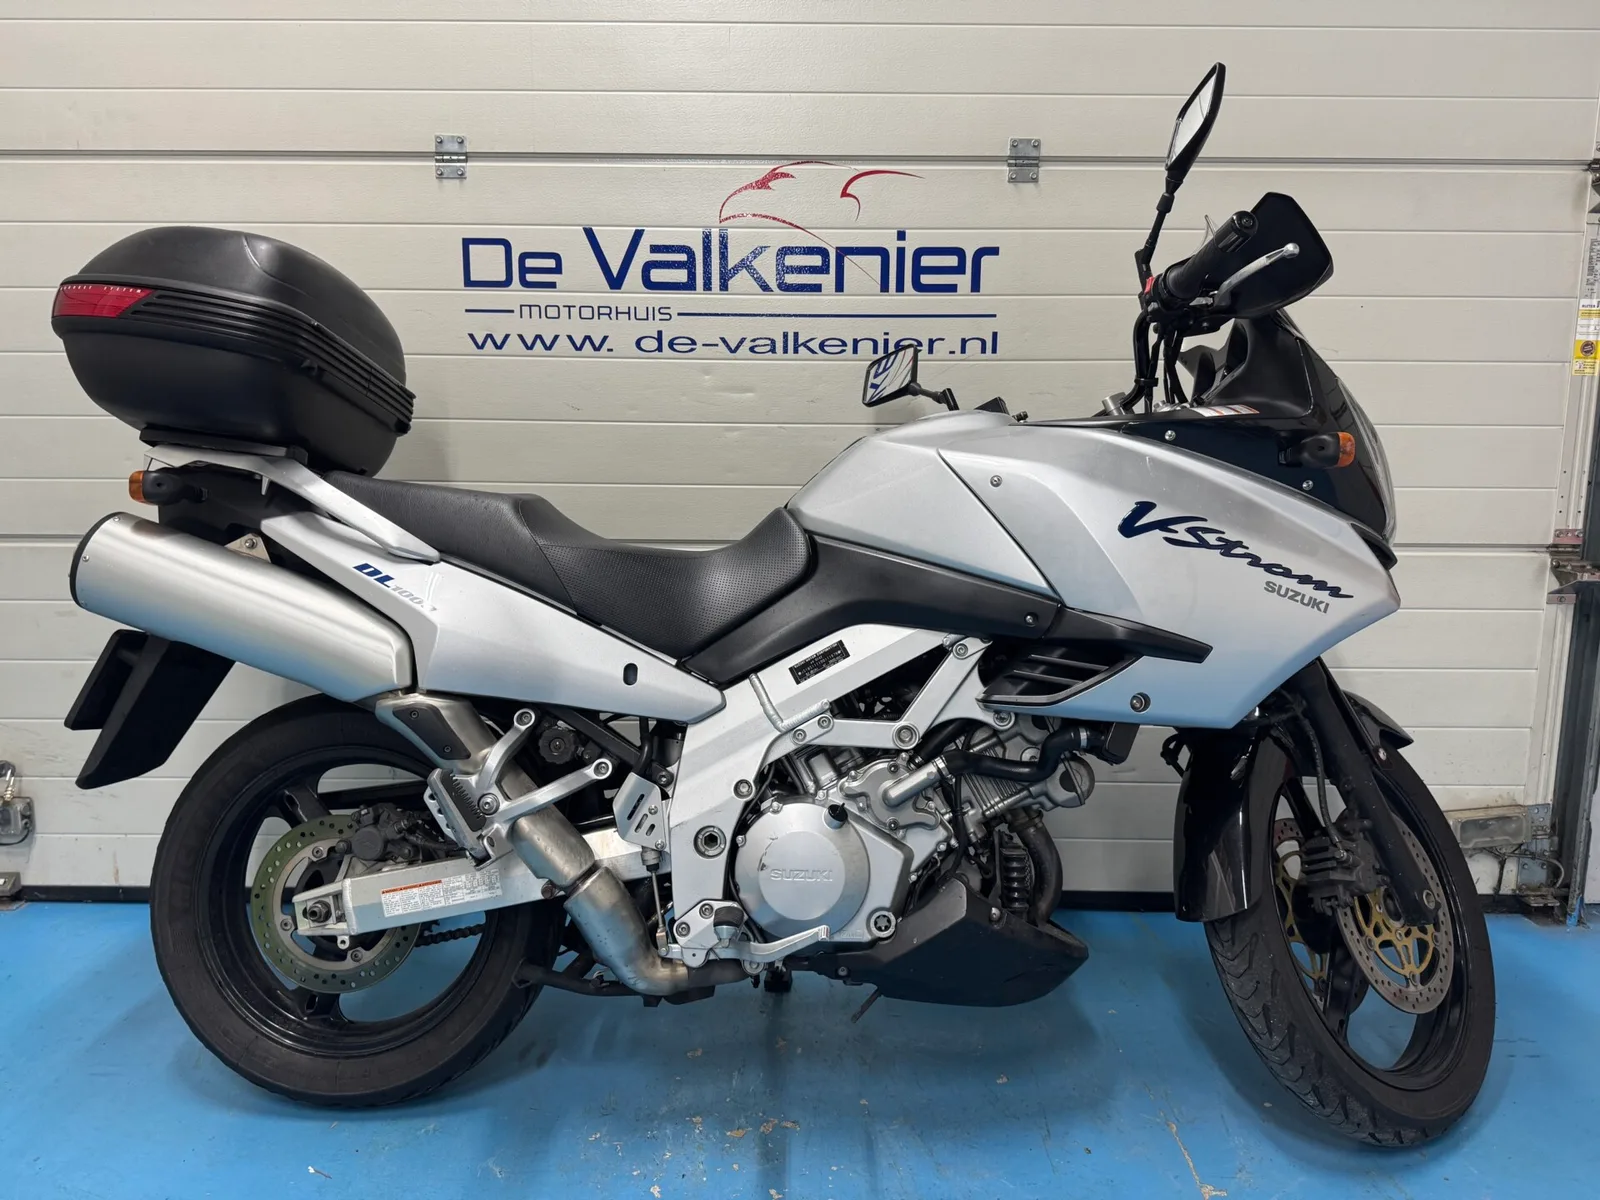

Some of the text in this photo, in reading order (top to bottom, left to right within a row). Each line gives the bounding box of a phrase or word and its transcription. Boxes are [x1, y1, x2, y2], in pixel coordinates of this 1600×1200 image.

[462, 226, 1000, 293] De Valkenier
[519, 304, 673, 321] MOTORHUIS
[1117, 500, 1355, 599] V-Strom
[1263, 580, 1330, 614] SUZUKI
[769, 868, 833, 882] SUZUKI
